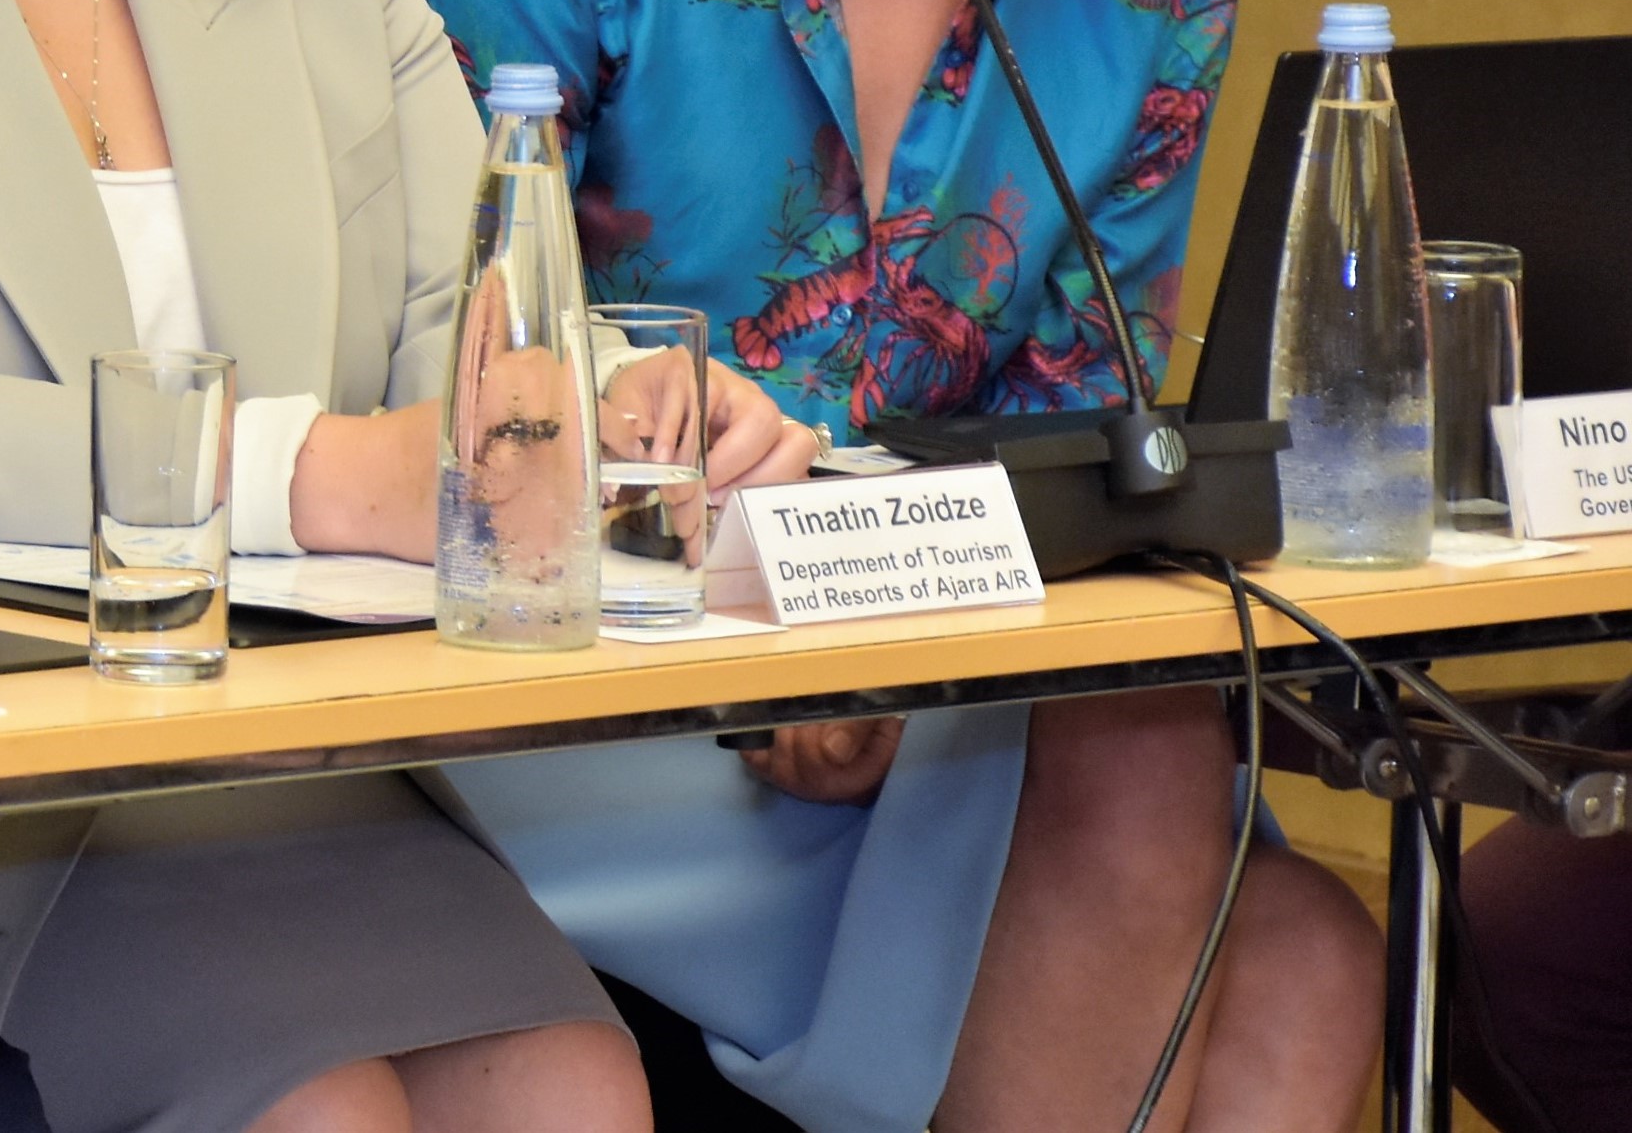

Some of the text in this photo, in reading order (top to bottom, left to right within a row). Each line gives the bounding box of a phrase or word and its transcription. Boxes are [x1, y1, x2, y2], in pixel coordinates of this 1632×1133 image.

[1559, 416, 1627, 447] Nino
[1573, 468, 1607, 488] The
[773, 493, 987, 537] Tinatin Zoidze
[1580, 498, 1632, 517] Gove
[778, 542, 1013, 583] Department of Tourism
[782, 568, 1032, 613] and Resorts of Ajara A/R
